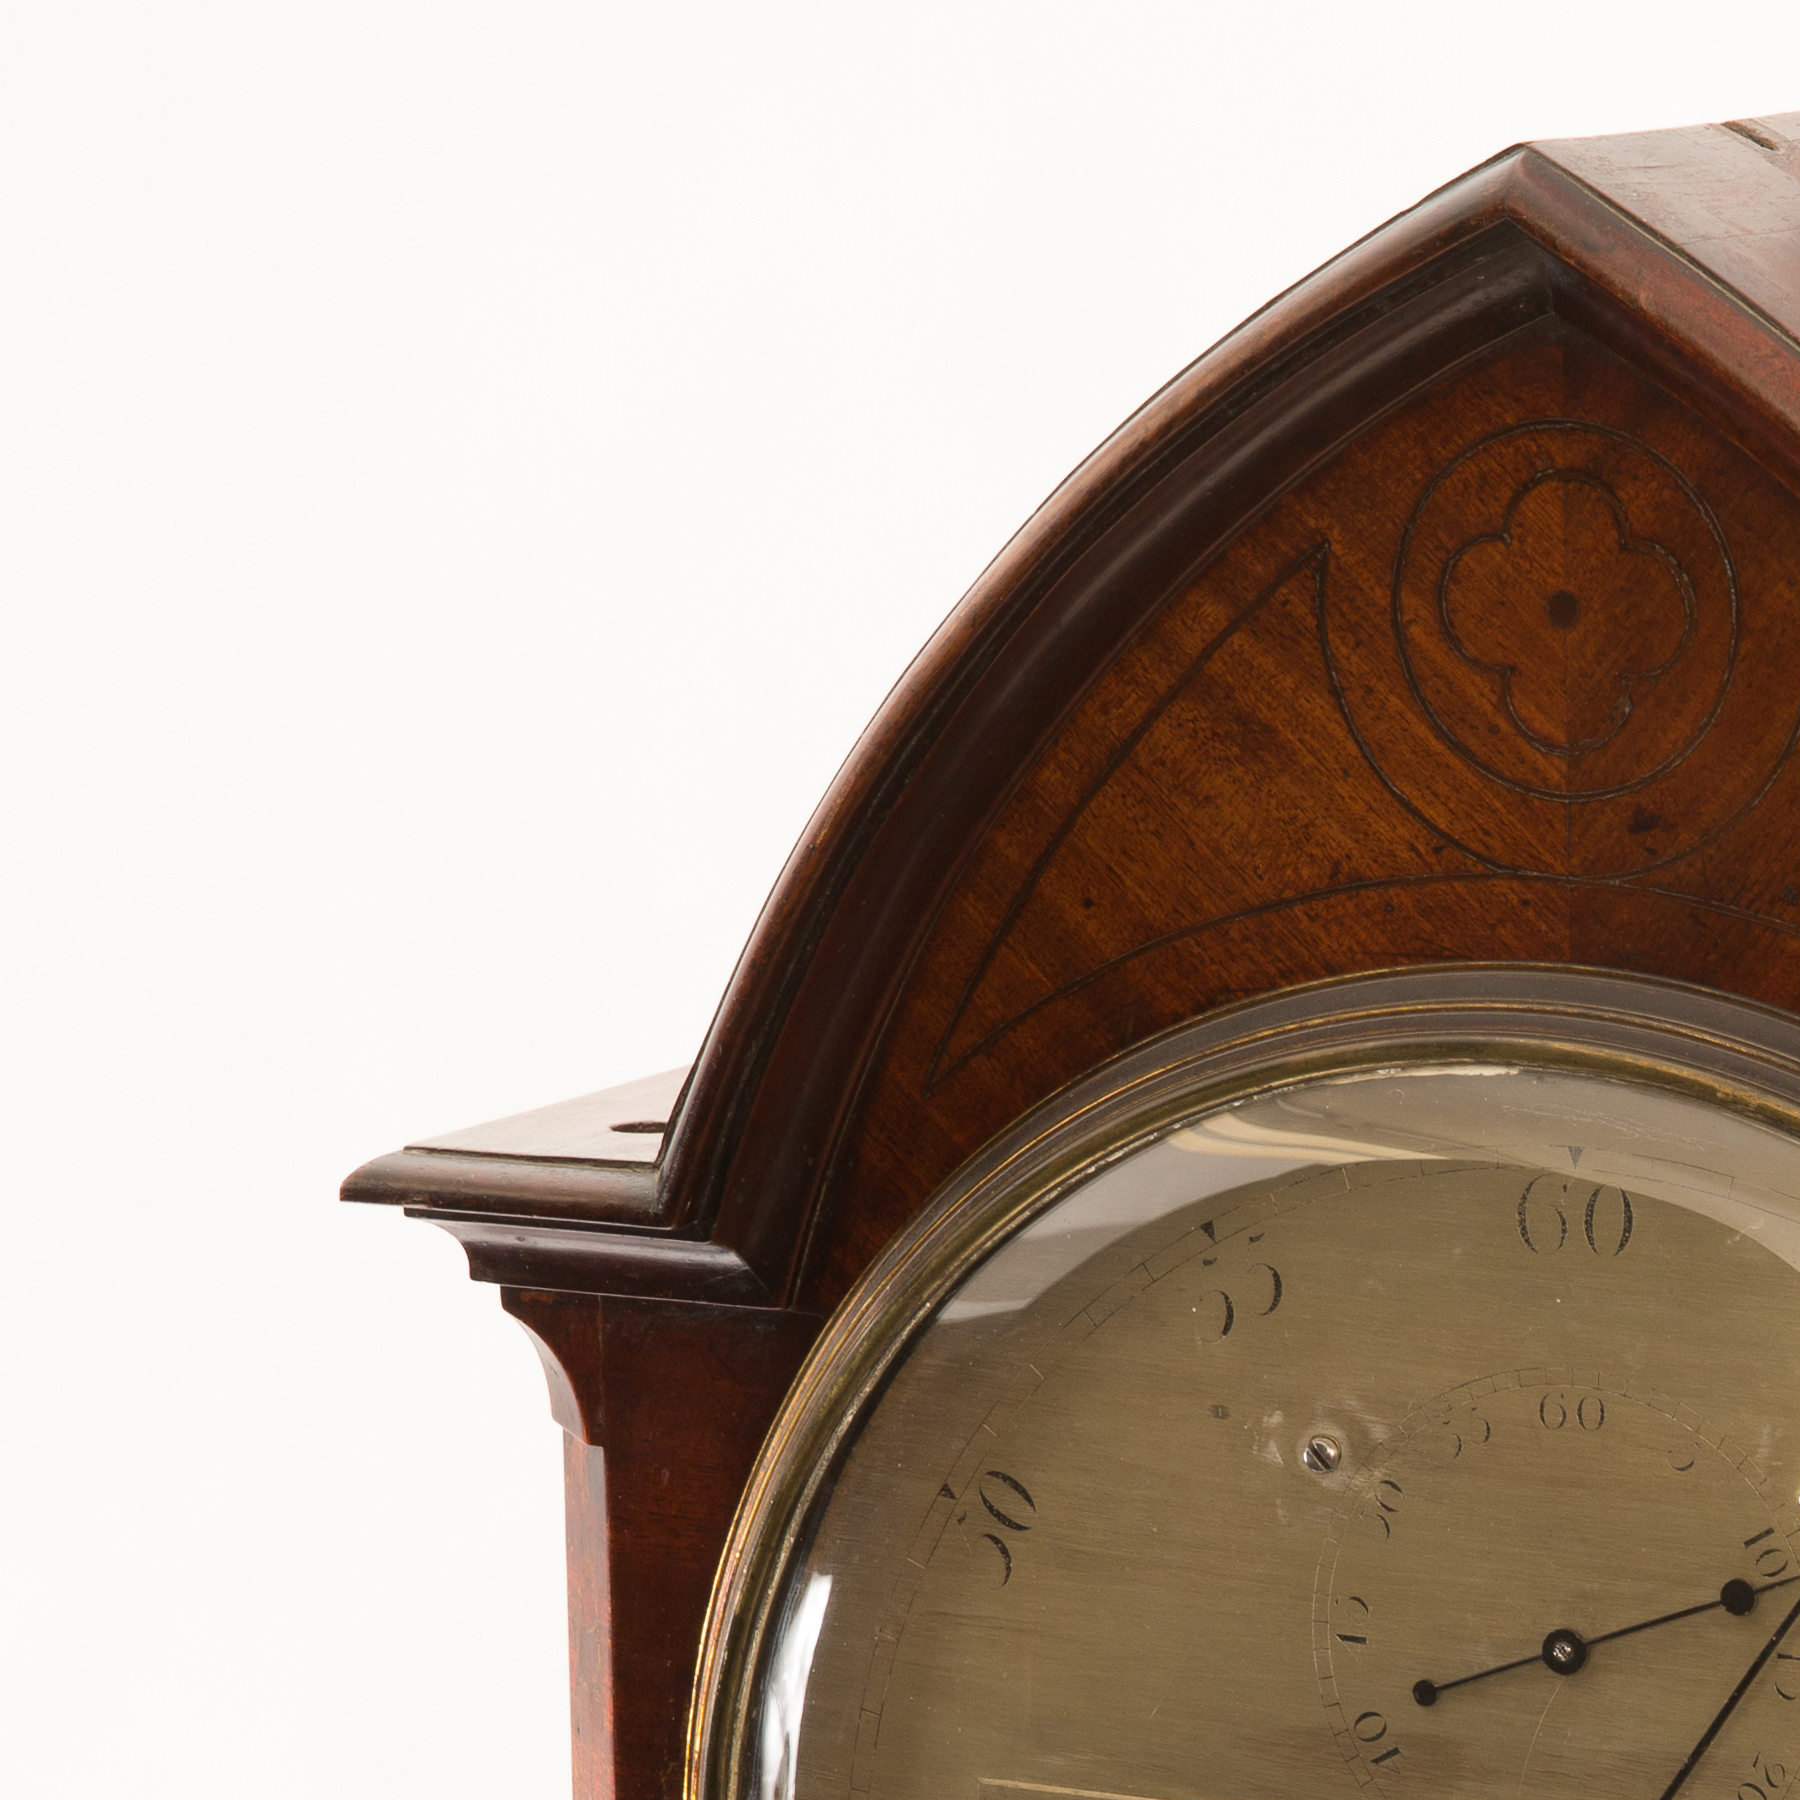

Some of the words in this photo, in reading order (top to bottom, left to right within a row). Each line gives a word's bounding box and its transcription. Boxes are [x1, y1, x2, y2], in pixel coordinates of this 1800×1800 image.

[1517, 1174, 1634, 1257] 60
[1539, 1392, 1605, 1431] 60
[956, 1471, 1037, 1586] 50
[1744, 1527, 1788, 1582] 10
